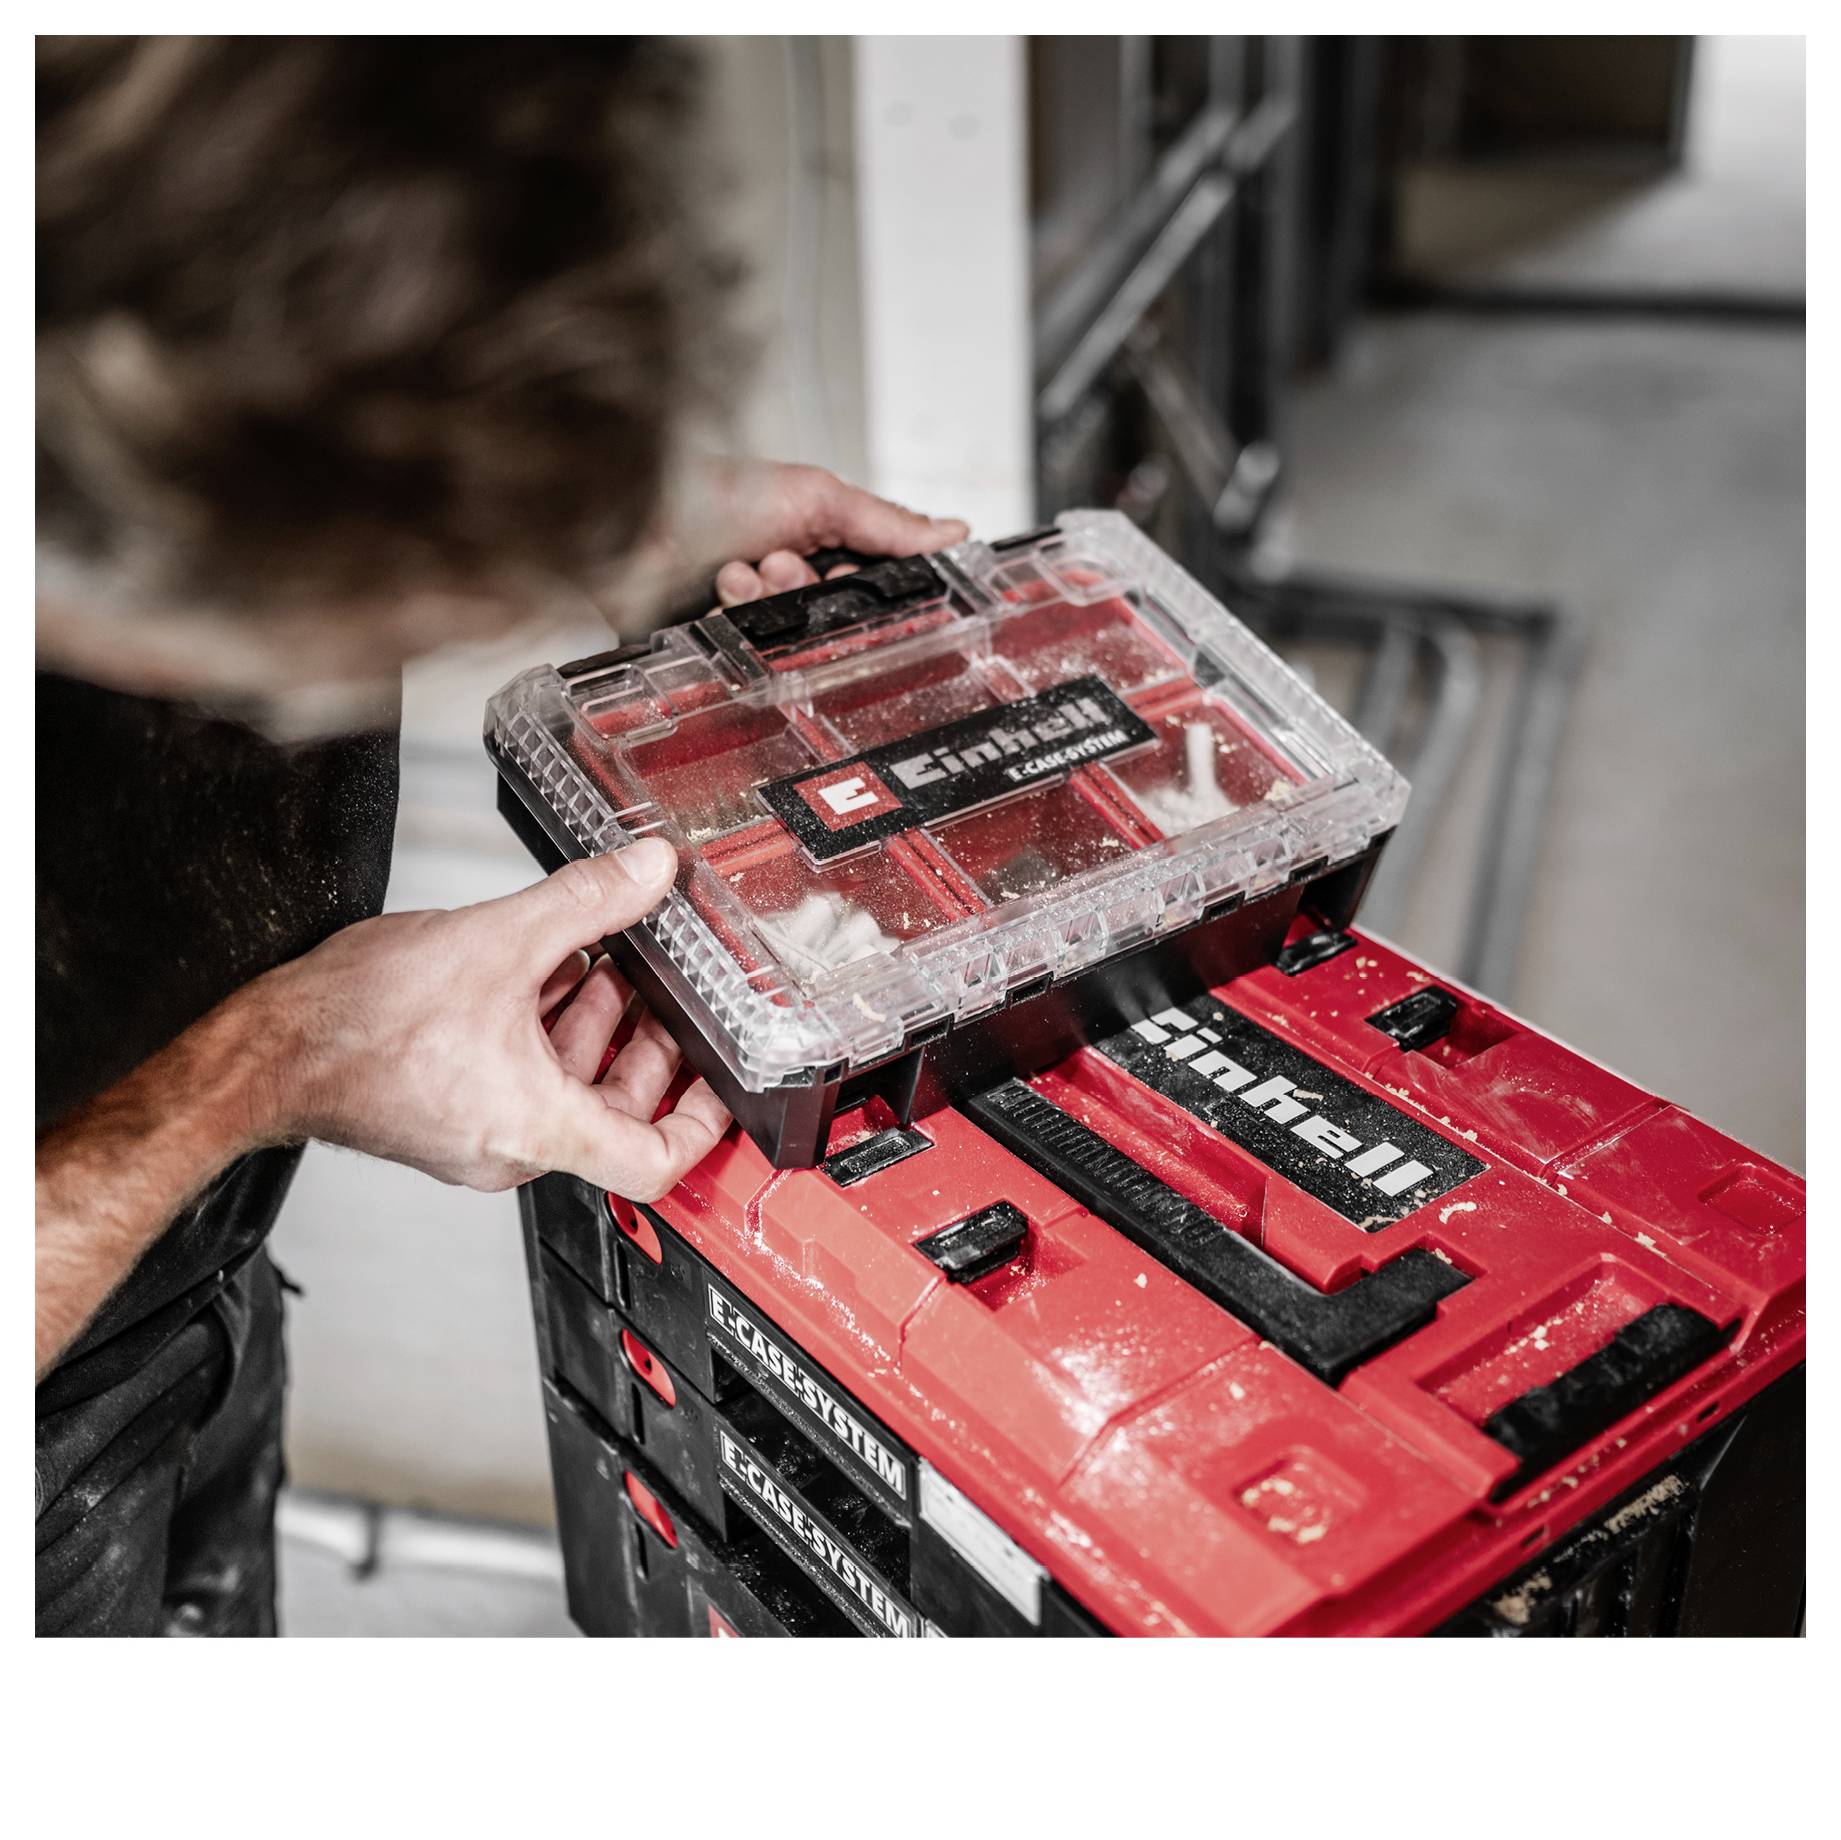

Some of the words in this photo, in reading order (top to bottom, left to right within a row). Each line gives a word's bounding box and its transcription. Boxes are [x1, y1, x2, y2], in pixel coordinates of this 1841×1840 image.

[889, 697, 1109, 790] Einhell
[711, 1289, 904, 1495] E-CASE-SYSTEM
[724, 1437, 909, 1638] E-CASE-SYSTEM
